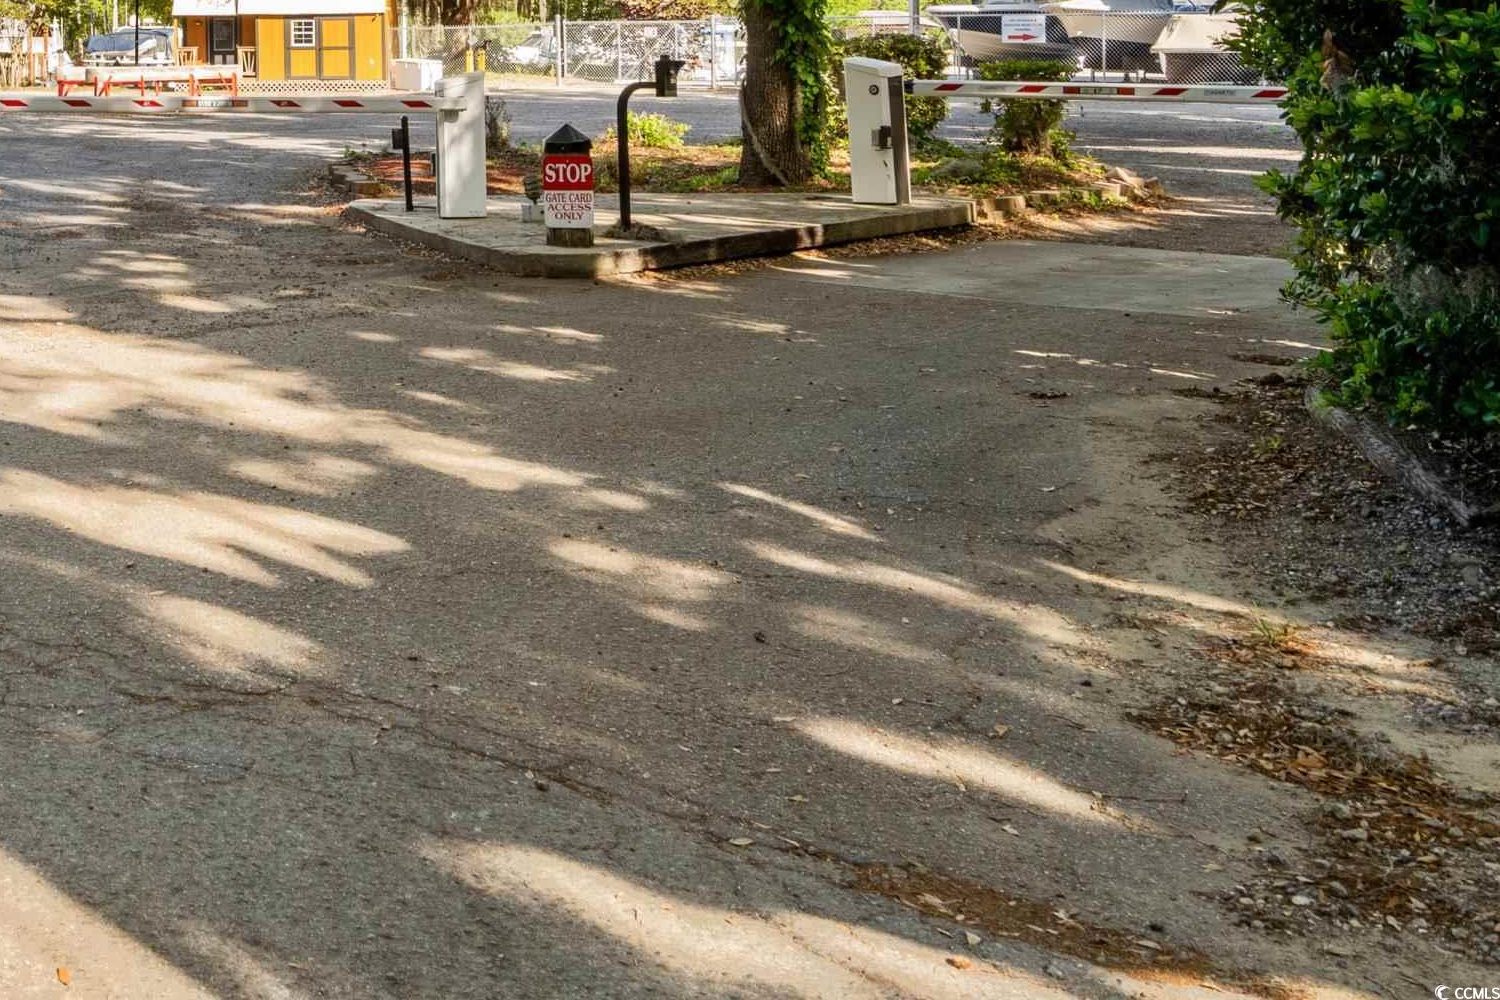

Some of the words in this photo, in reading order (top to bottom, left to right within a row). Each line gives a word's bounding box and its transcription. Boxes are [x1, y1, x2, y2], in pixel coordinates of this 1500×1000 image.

[545, 163, 592, 183] STOP
[546, 193, 566, 202] GATE
[569, 192, 592, 202] CARD
[548, 203, 591, 211] ACCESS
[554, 212, 584, 220] ONLY
